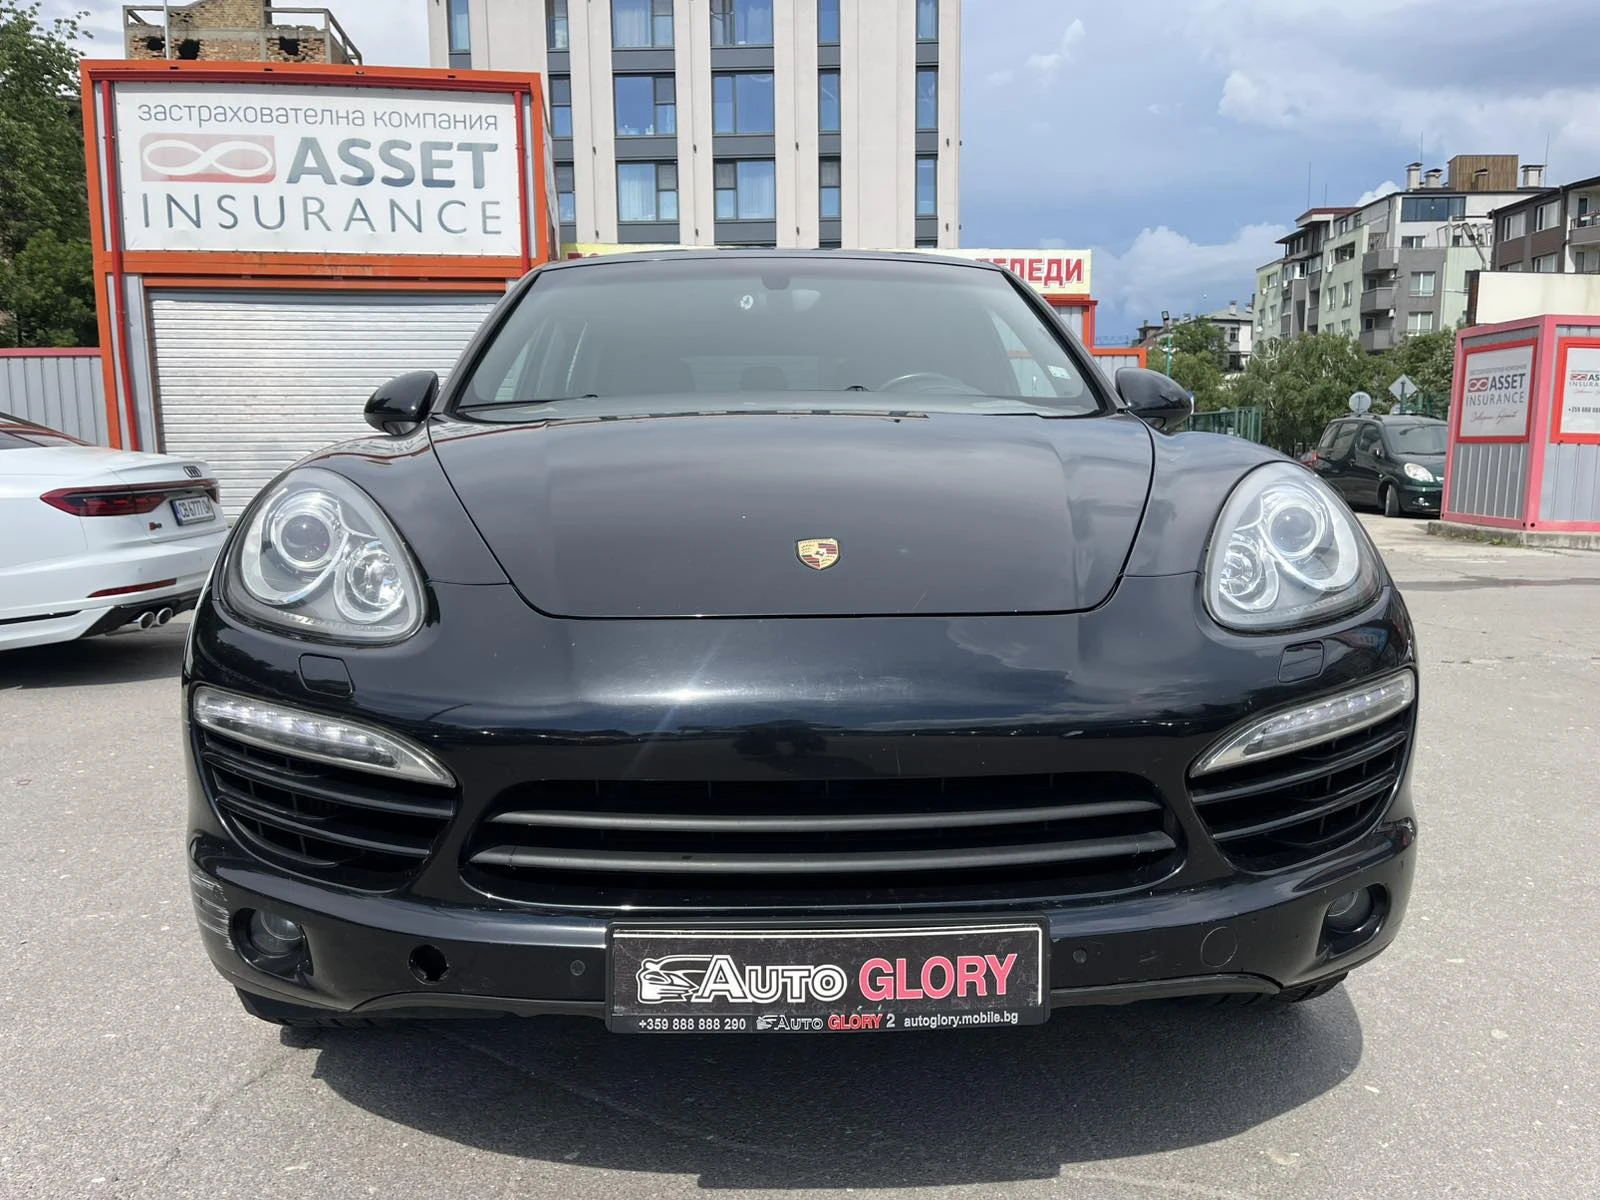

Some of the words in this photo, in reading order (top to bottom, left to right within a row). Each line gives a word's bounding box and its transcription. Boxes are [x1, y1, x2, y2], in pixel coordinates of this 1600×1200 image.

[138, 104, 365, 128] застрахователна
[374, 110, 498, 130] компания
[286, 137, 498, 189] ASSET
[142, 193, 502, 234] INSURANCE
[1489, 373, 1526, 391] ASSET
[1465, 391, 1525, 406] INSURANCE
[859, 953, 1018, 1000] GLORY
[638, 1017, 669, 1030] +359
[672, 1017, 695, 1030] 888
[698, 1017, 721, 1030] 888
[724, 1017, 747, 1030] 290
[828, 1013, 882, 1030] GLORY
[886, 1013, 896, 1028] 2
[904, 1010, 1018, 1028] autoglory.mobile.bg
